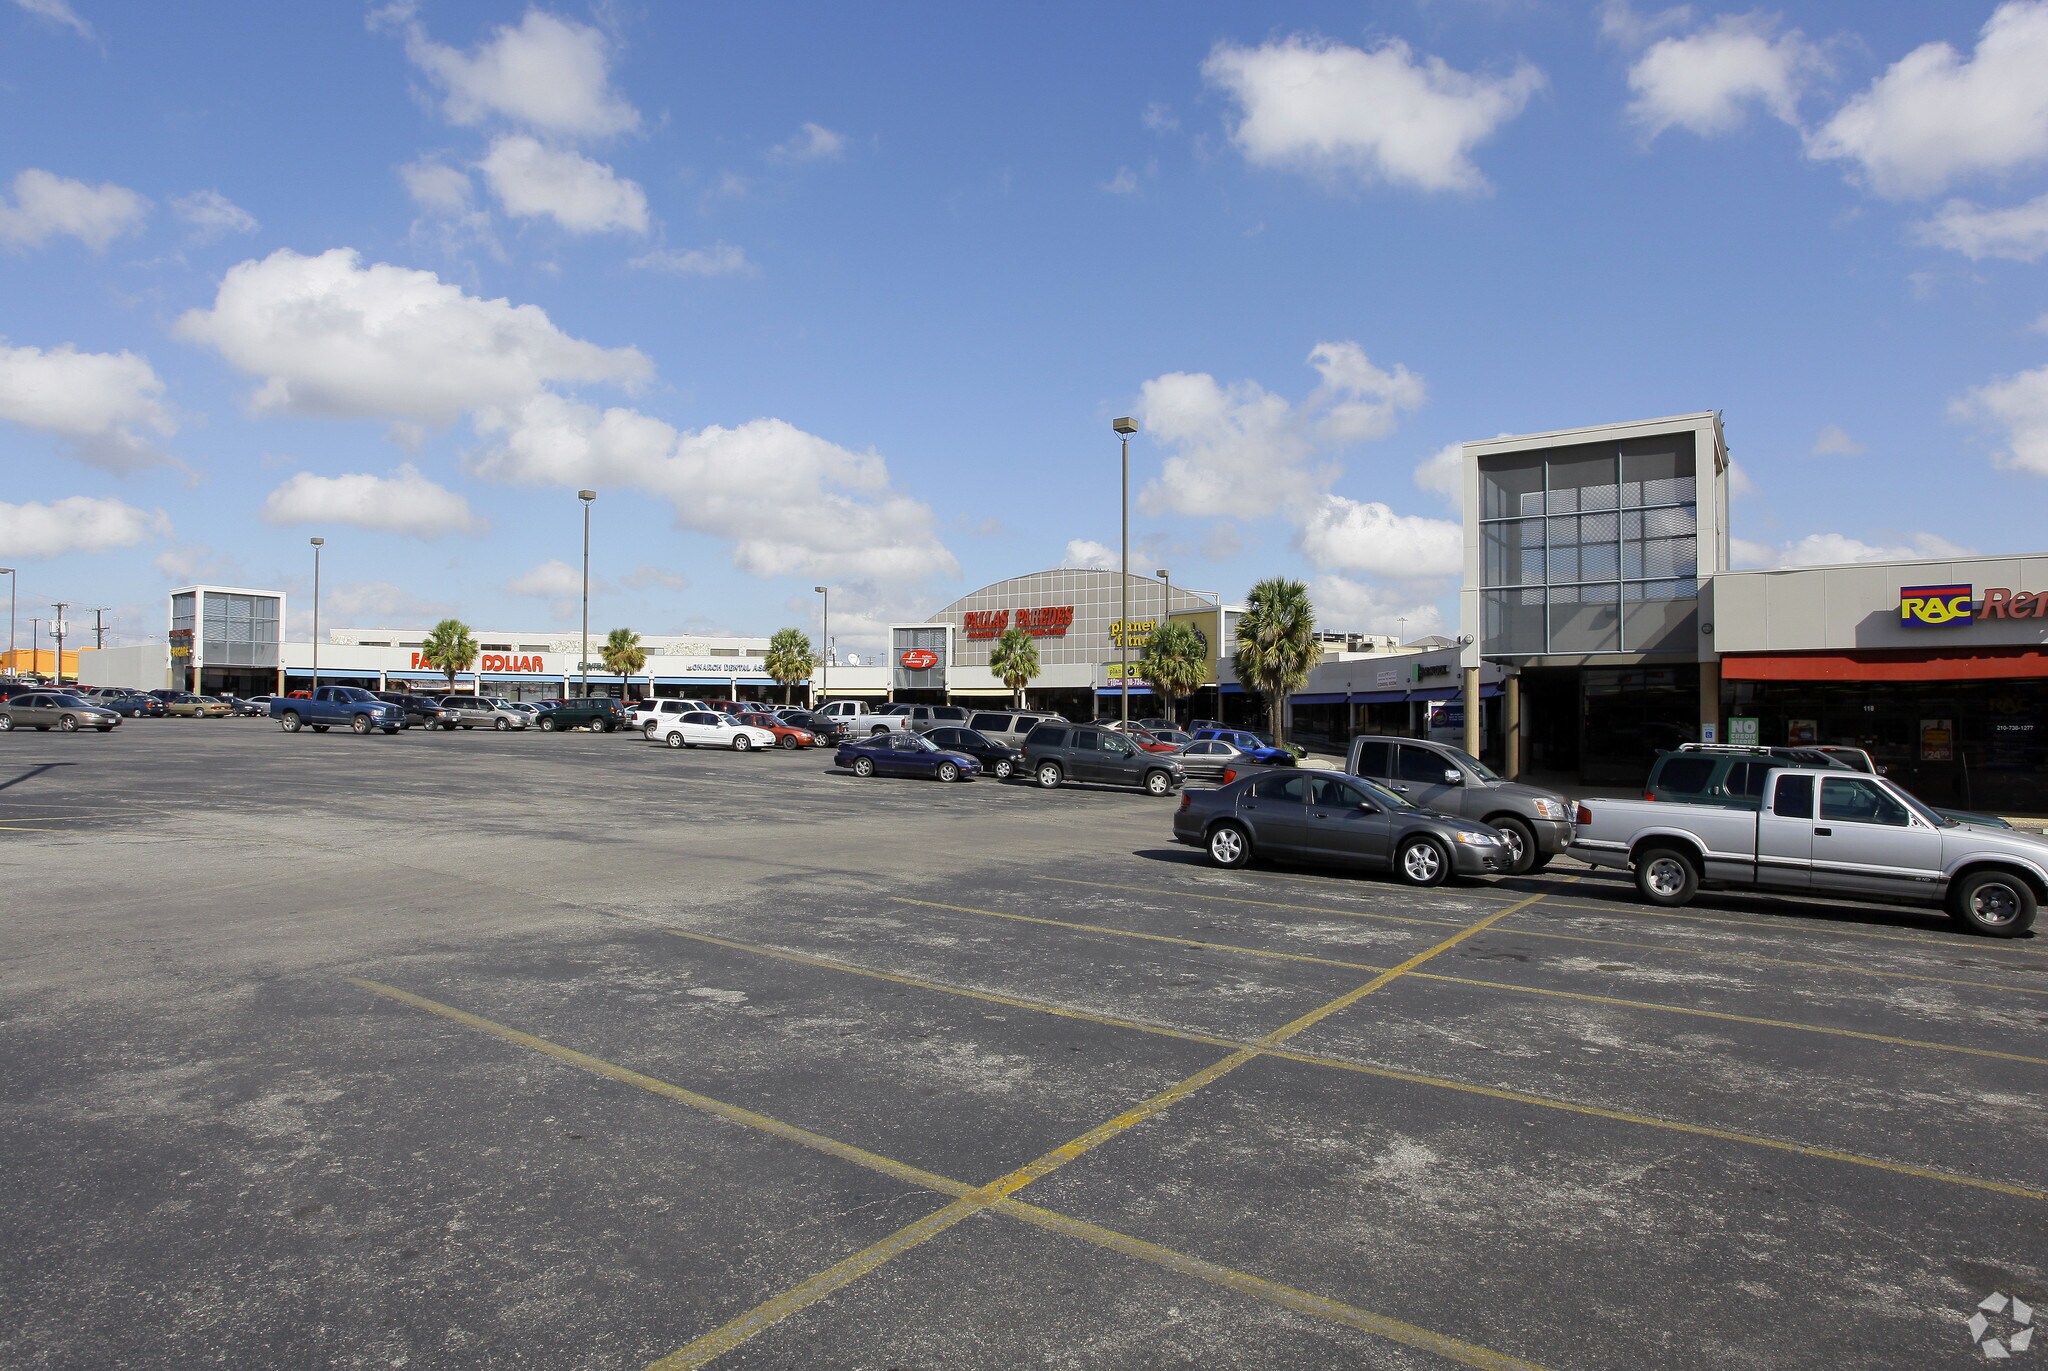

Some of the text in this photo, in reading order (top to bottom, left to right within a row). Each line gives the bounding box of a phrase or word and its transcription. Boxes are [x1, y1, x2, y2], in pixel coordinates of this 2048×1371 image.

[964, 605, 1074, 630] FALLAS PAREDES
[1901, 596, 1971, 624] RAC
[481, 654, 544, 673] DOLLAR
[723, 663, 751, 672] DENTAL
[1731, 720, 1756, 734] NO
